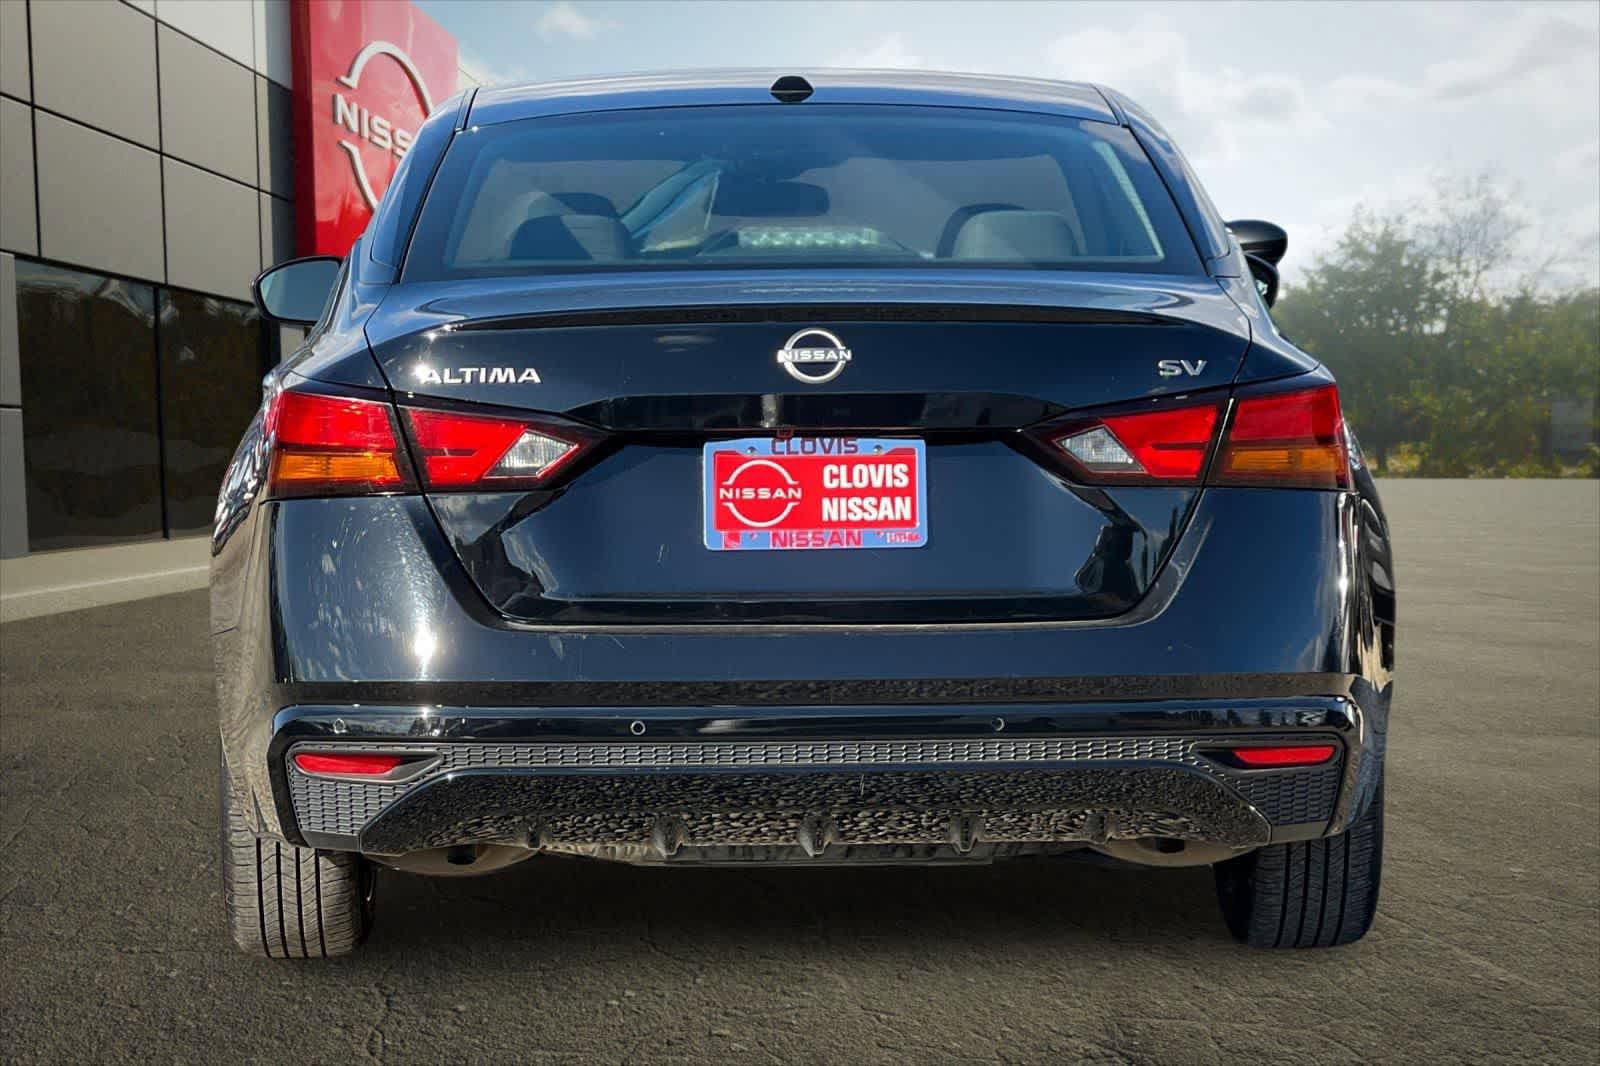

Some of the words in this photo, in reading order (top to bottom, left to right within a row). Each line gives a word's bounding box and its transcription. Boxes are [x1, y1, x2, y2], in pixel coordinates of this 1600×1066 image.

[332, 93, 415, 160] NISS
[777, 348, 852, 363] NISSAN
[415, 366, 541, 384] ALTIMA
[1158, 359, 1207, 376] SV
[771, 437, 859, 455] CLOVIS
[823, 463, 909, 489] CLOVIS
[719, 487, 802, 500] NISSAN
[821, 496, 912, 522] NISSAN
[770, 530, 862, 549] NISSAN
